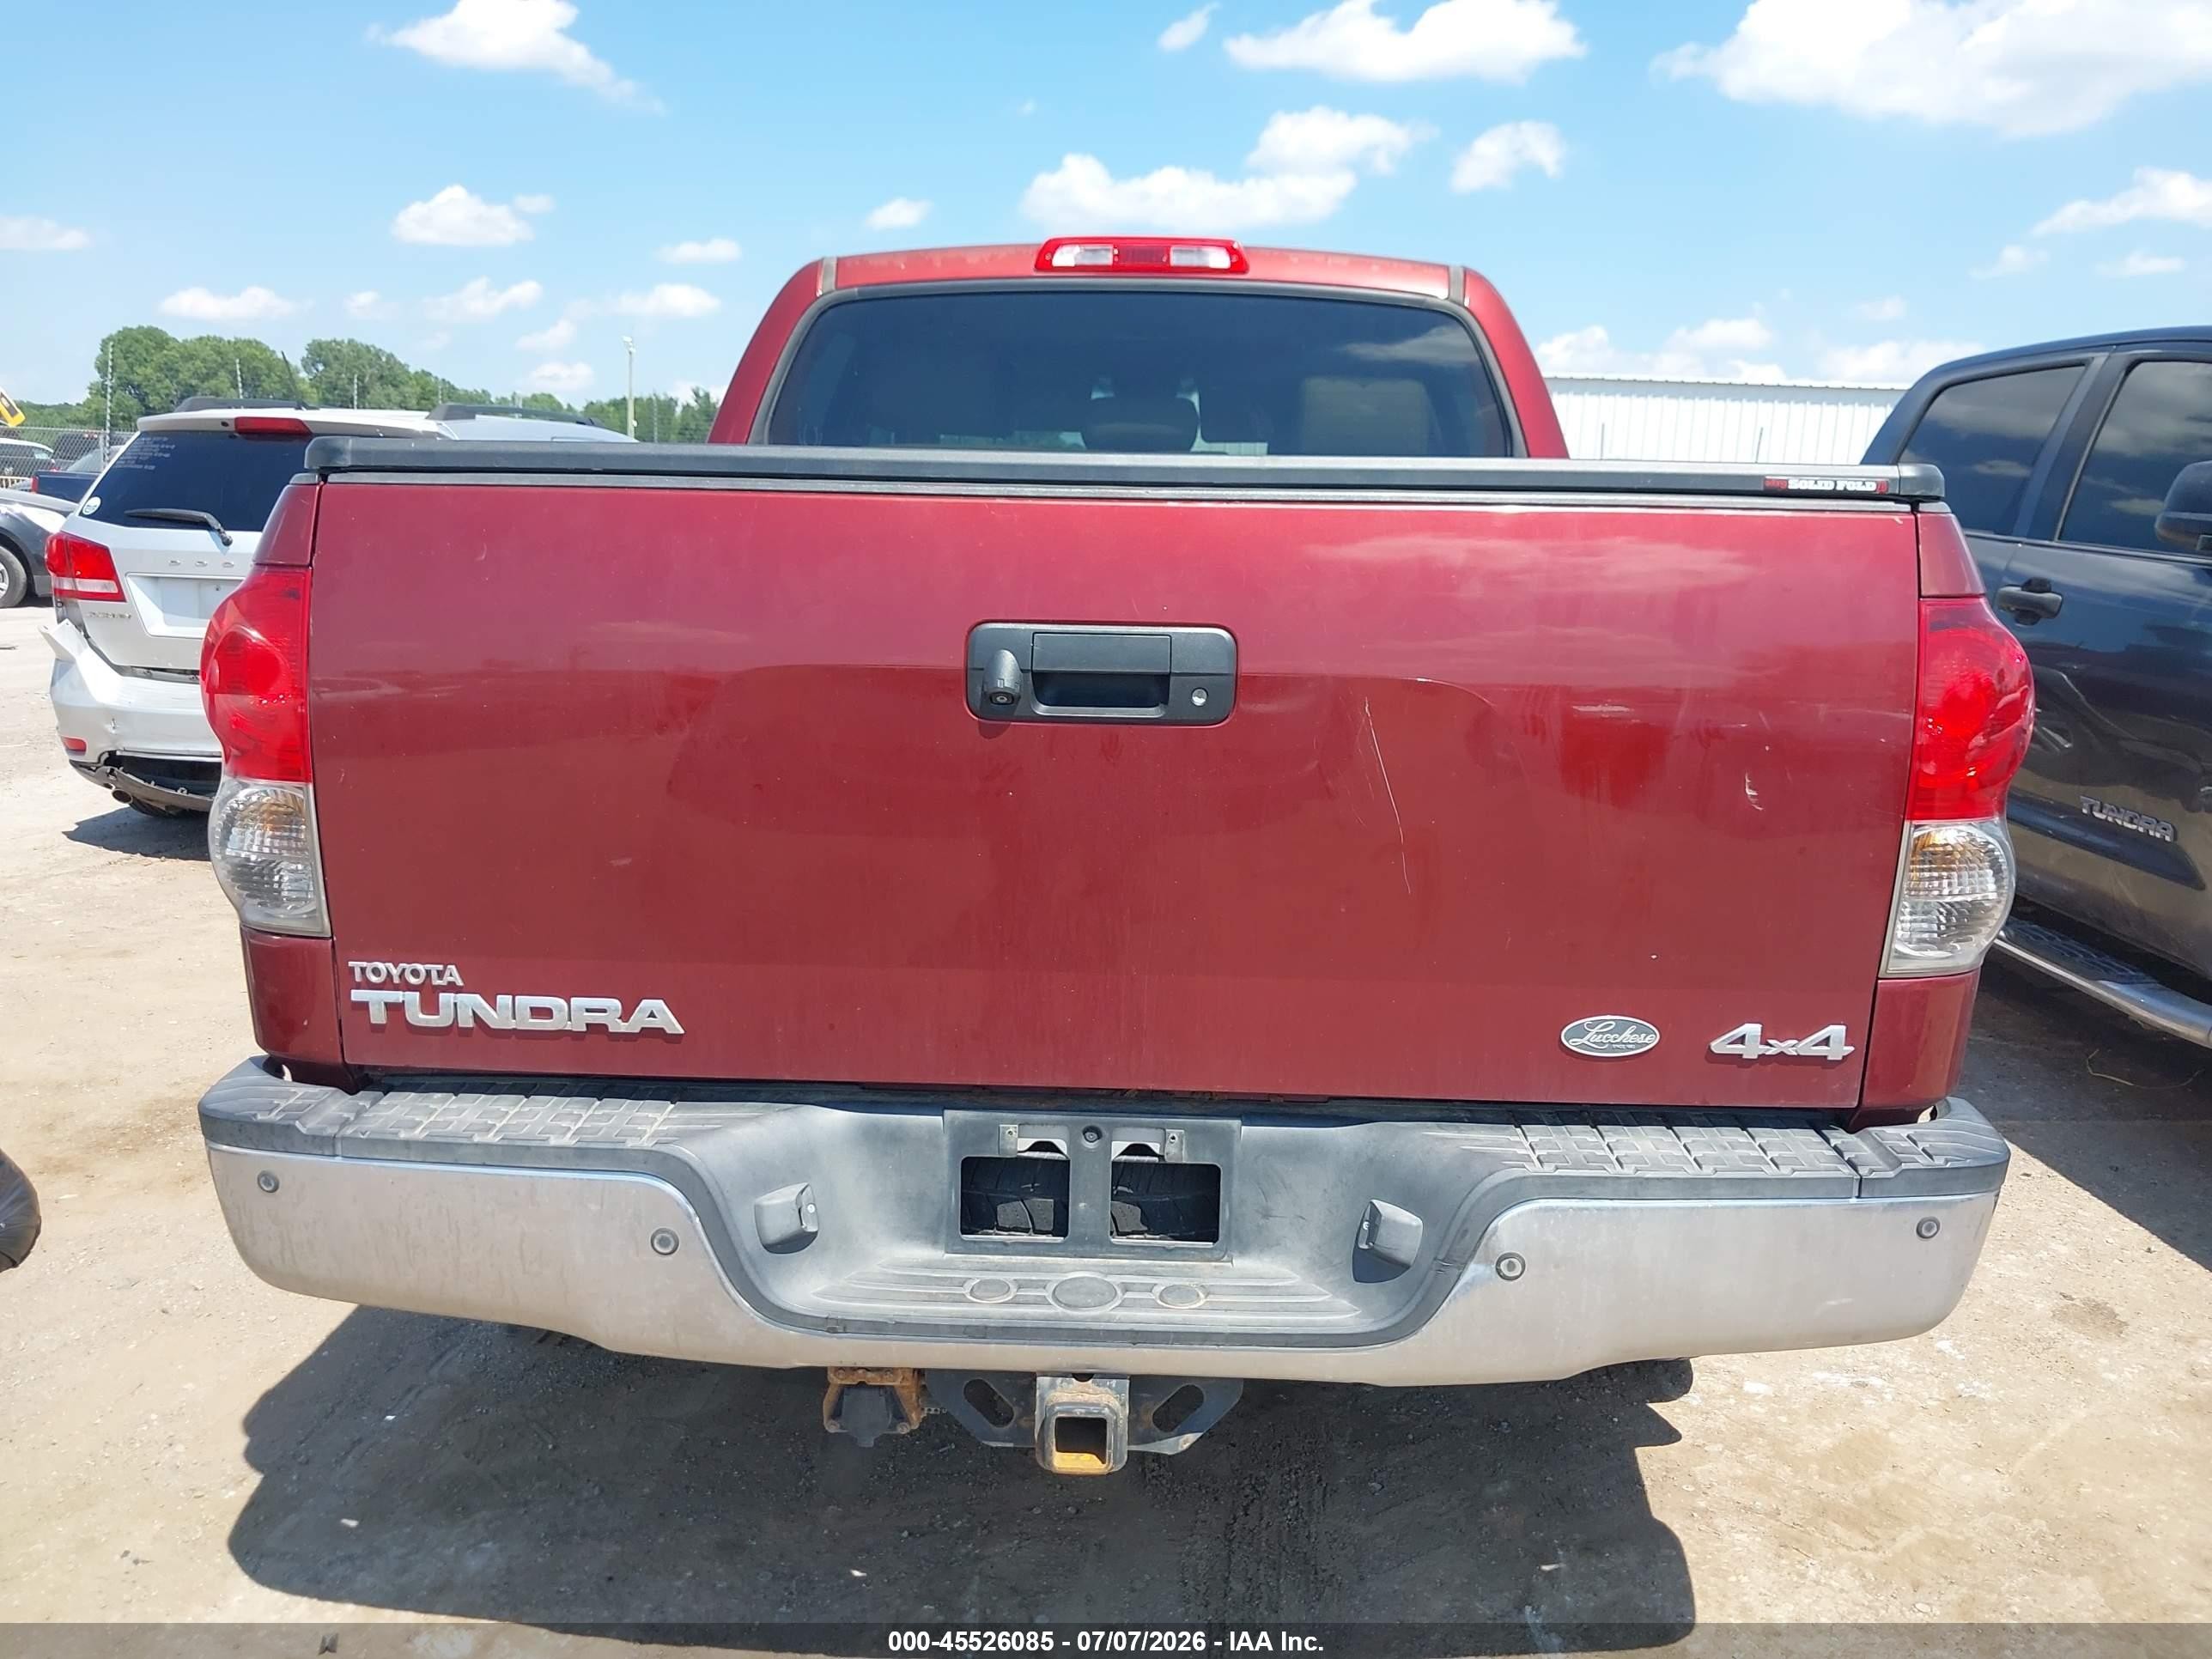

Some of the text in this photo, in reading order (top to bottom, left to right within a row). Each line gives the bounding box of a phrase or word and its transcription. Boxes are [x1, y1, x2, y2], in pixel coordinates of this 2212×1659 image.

[1788, 479, 1835, 490] SOLID
[1836, 480, 1877, 492] FOLD
[2080, 795, 2174, 842] TUNDRA
[348, 960, 464, 986] TOYOTA
[350, 989, 685, 1035] TUNDRA
[1568, 1020, 1656, 1049] Lucchese
[1710, 1023, 1856, 1060] 4x4
